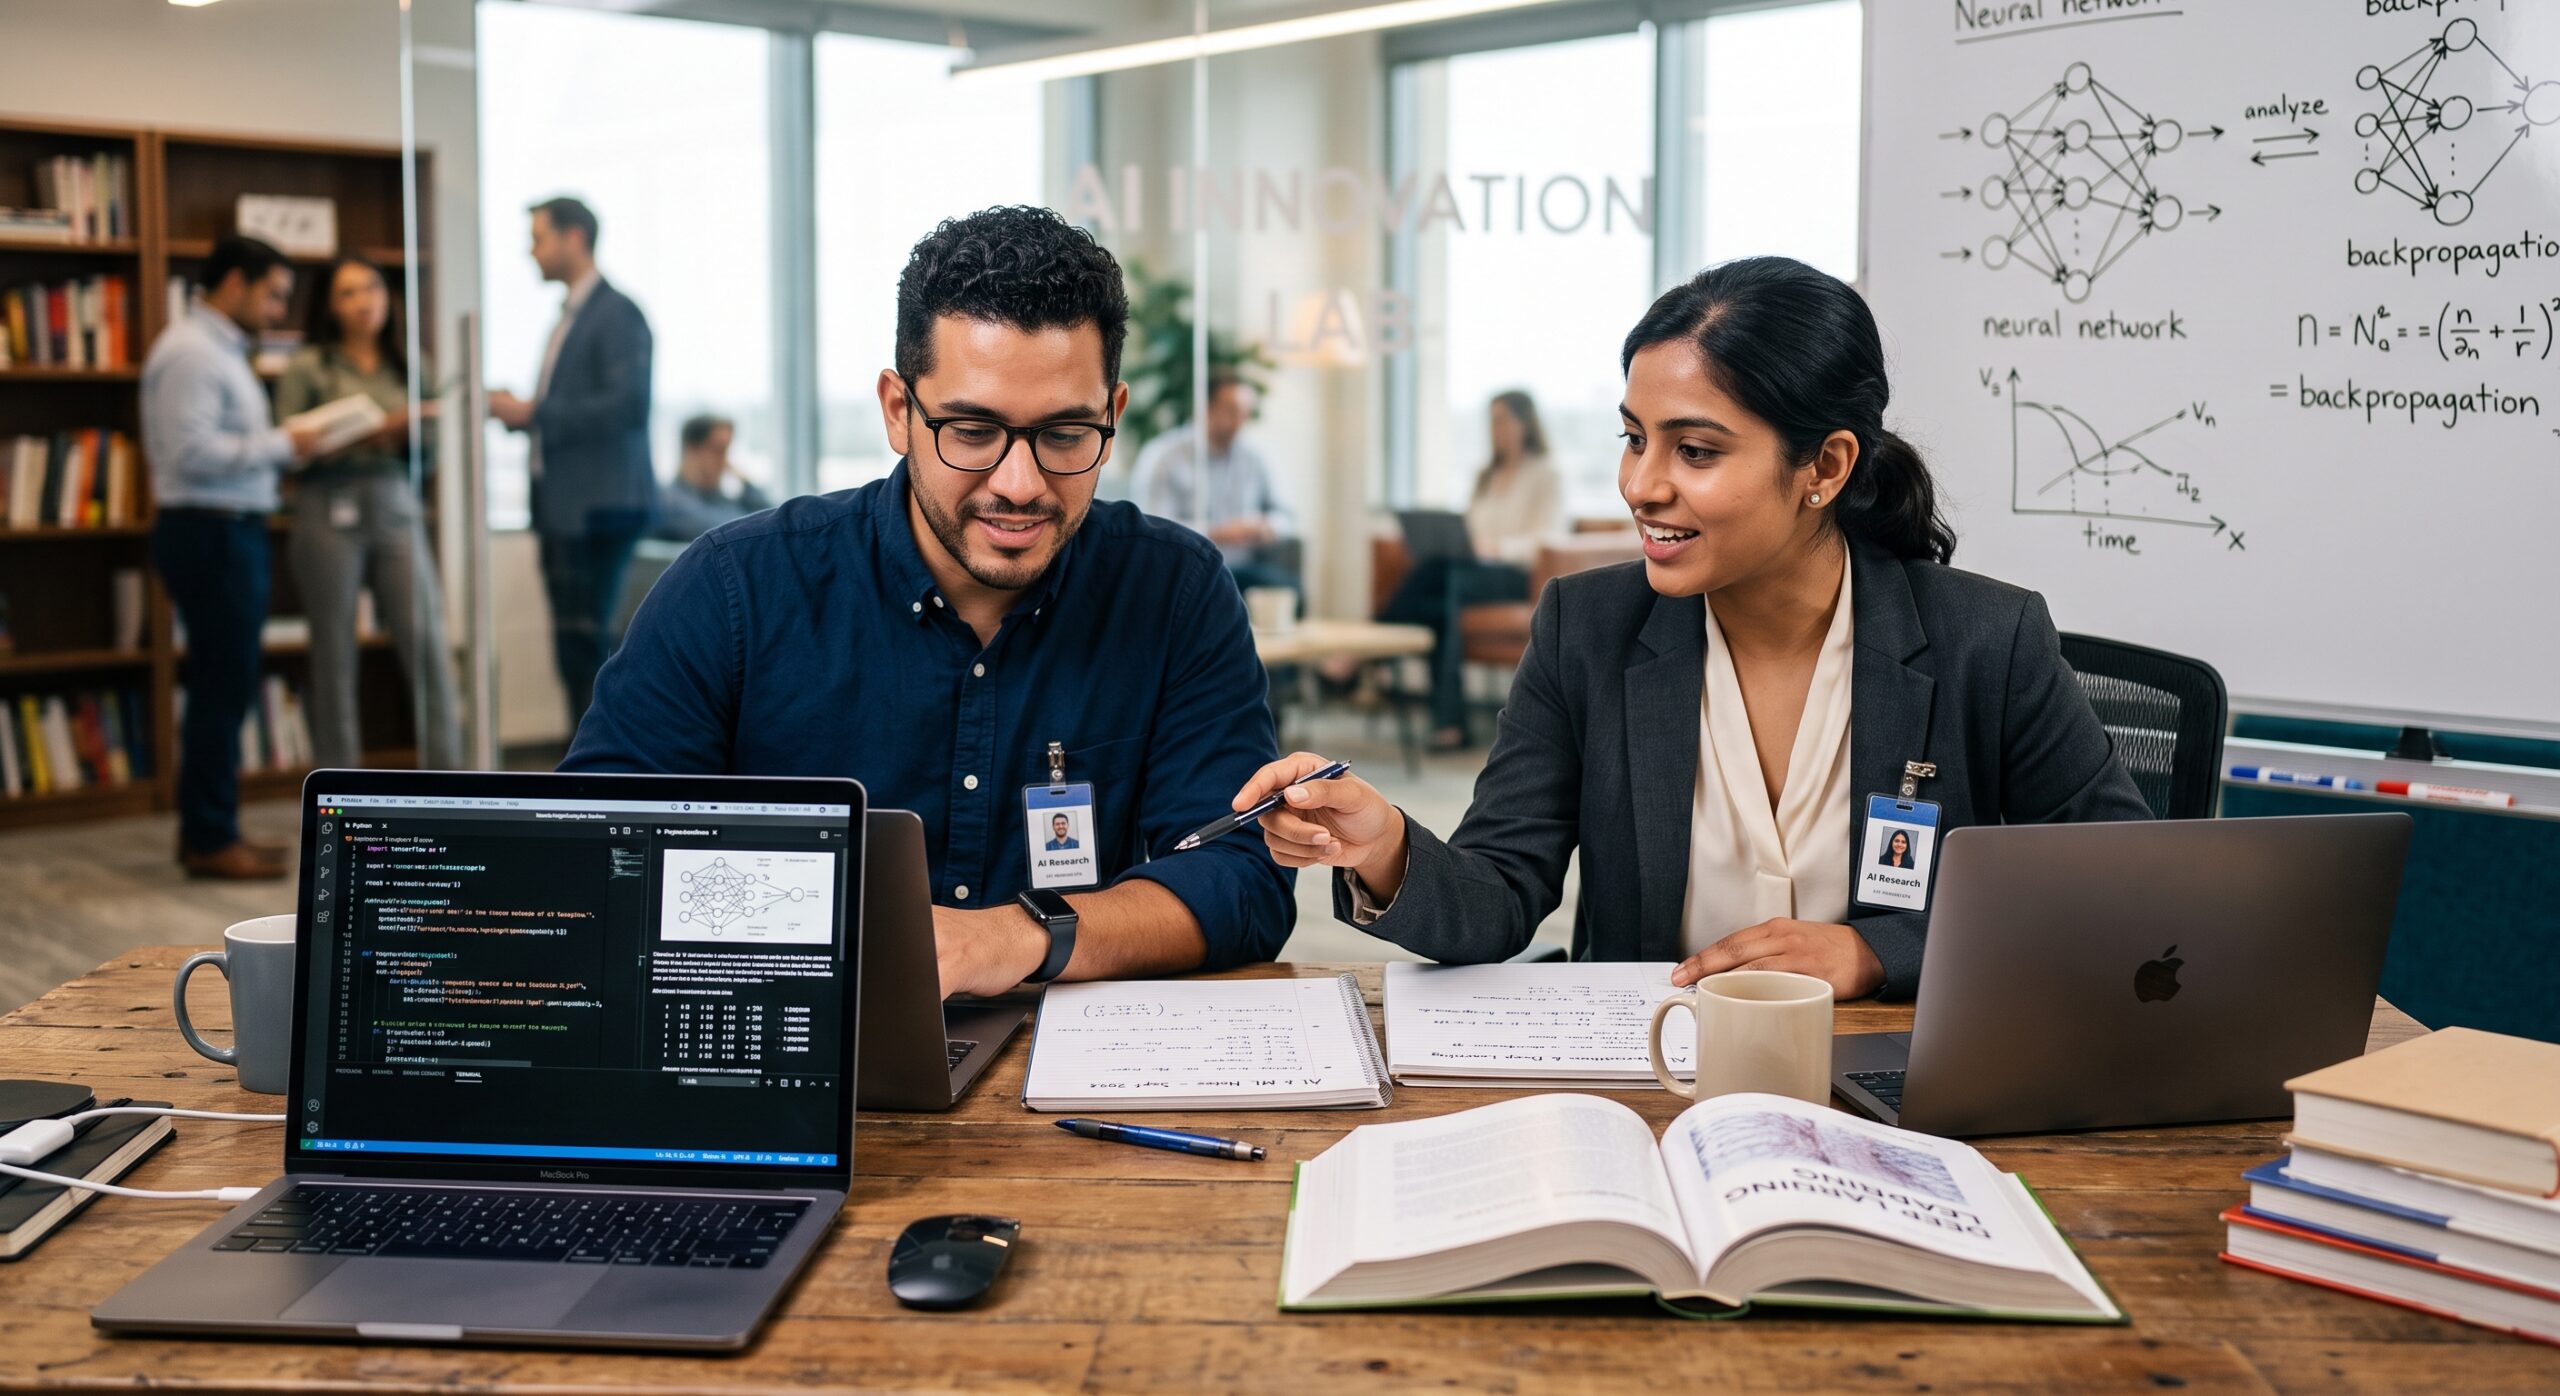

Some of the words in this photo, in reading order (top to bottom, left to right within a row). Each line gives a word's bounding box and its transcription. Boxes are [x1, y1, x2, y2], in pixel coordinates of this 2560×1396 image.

[1955, 0, 2042, 31] Neural
[2245, 93, 2329, 123] analyze
[1071, 164, 1143, 234] AI
[1171, 165, 1655, 235] INNOVATION
[1267, 291, 1416, 353] LAB
[1983, 308, 2062, 338] neural
[2079, 310, 2188, 339] network
[2300, 374, 2540, 429] backpropagation
[2082, 519, 2142, 556] time
[1037, 859, 1047, 868] AI
[1049, 857, 1090, 867] Research
[1866, 872, 1877, 882] AI
[1878, 873, 1921, 888] Research
[540, 1170, 575, 1179] MacBook
[576, 1171, 590, 1180] Pro
